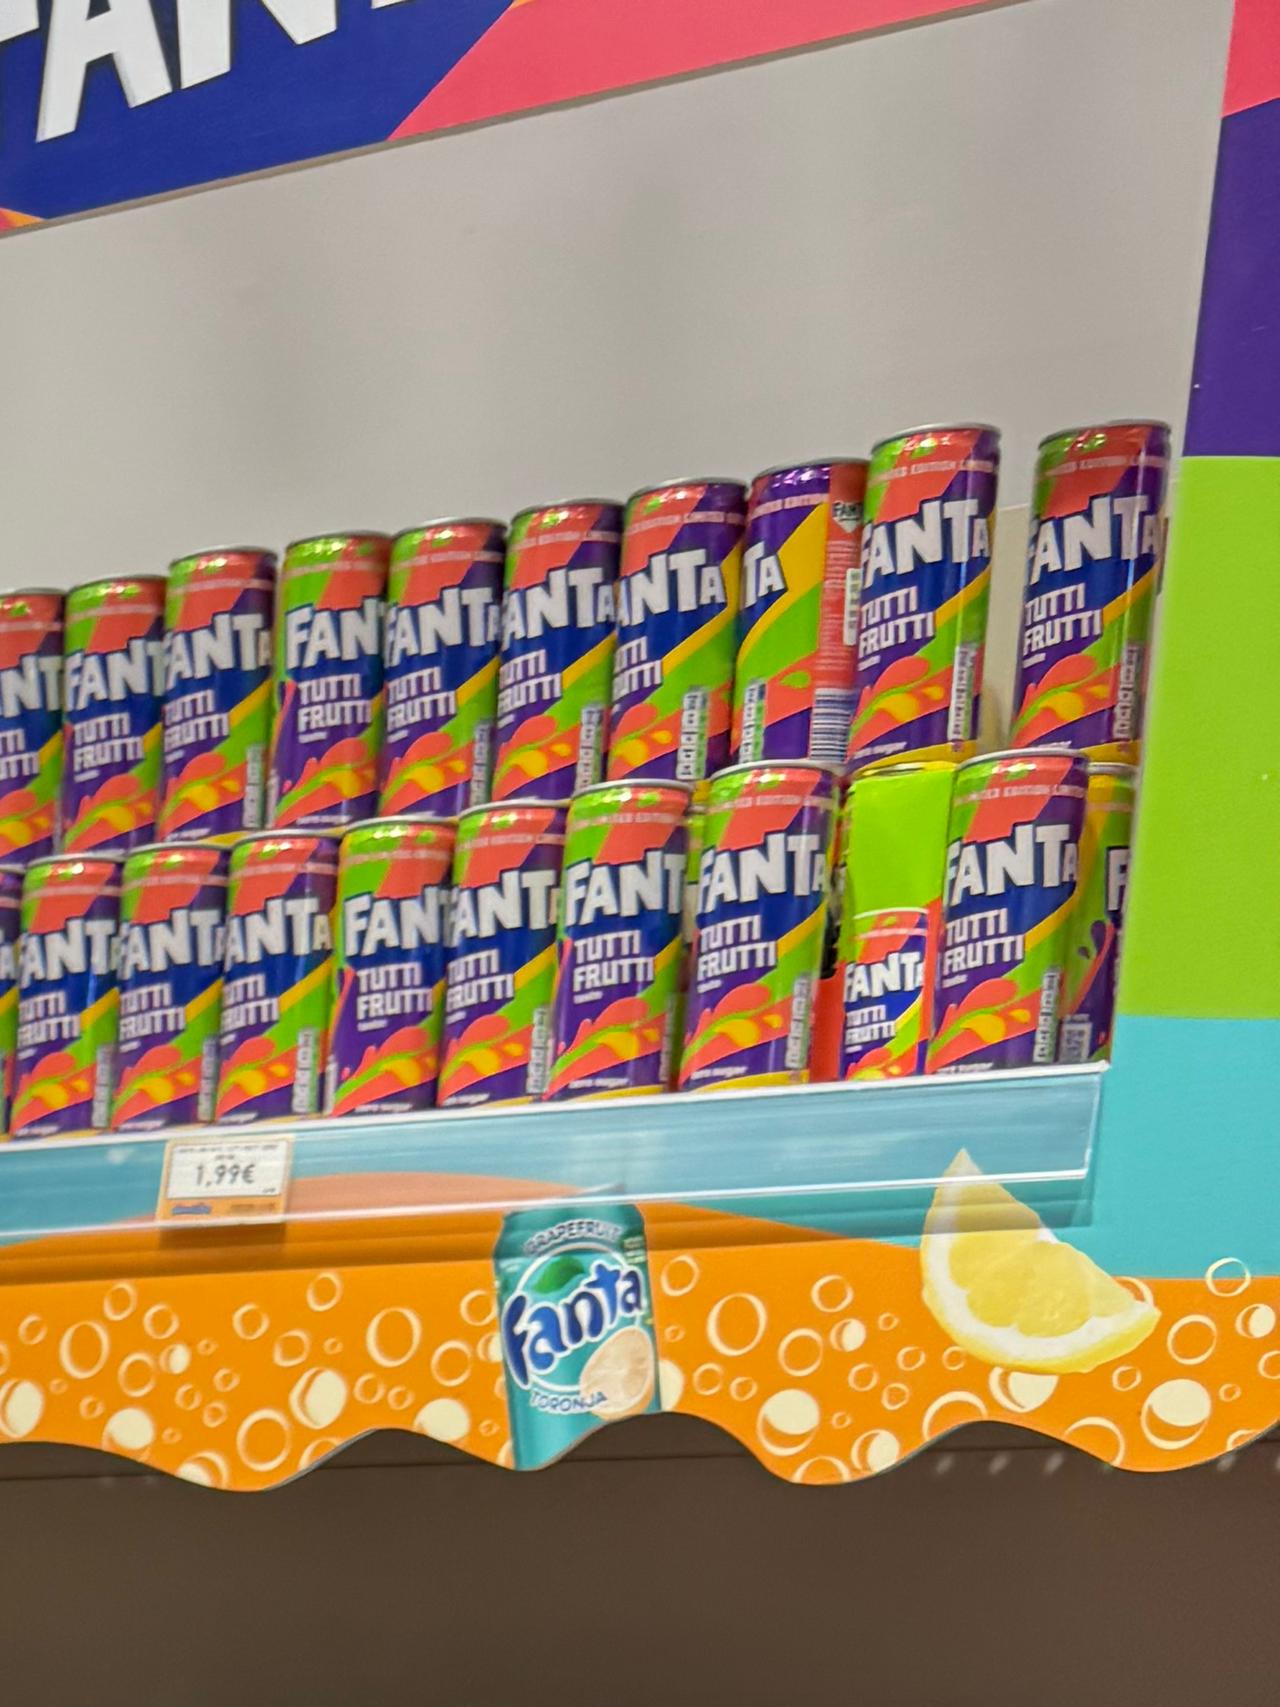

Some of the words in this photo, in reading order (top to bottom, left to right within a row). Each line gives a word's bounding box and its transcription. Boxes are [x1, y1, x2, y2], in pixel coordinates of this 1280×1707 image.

[861, 585, 918, 626] TUTTI
[1025, 583, 1085, 627] TUTTI
[859, 610, 936, 660] FRUTTI
[1023, 608, 1103, 659] FRUTTI
[298, 674, 361, 702] TUTTI
[387, 667, 441, 701] TUTTI
[73, 712, 130, 747] TUTTI
[297, 699, 373, 731] FRUTTI
[387, 690, 457, 732] FRUTTI
[73, 735, 145, 773] FRUTTI
[565, 850, 688, 929] FANT
[699, 914, 762, 952] TUTTI
[946, 908, 1008, 948] TUTTI
[573, 930, 641, 965] TUTTI
[697, 940, 778, 981] FRUTTI
[943, 934, 1025, 975] FRUTTI
[357, 961, 423, 992] TUTTI
[573, 956, 656, 993] FRUTTI
[356, 988, 434, 1021] FRUTTI
[195, 1163, 256, 1188] 1,99€
[523, 1217, 625, 1258] GRAPEFRUIT
[501, 1258, 644, 1389] Fanta
[528, 1386, 610, 1413] TORONJA
